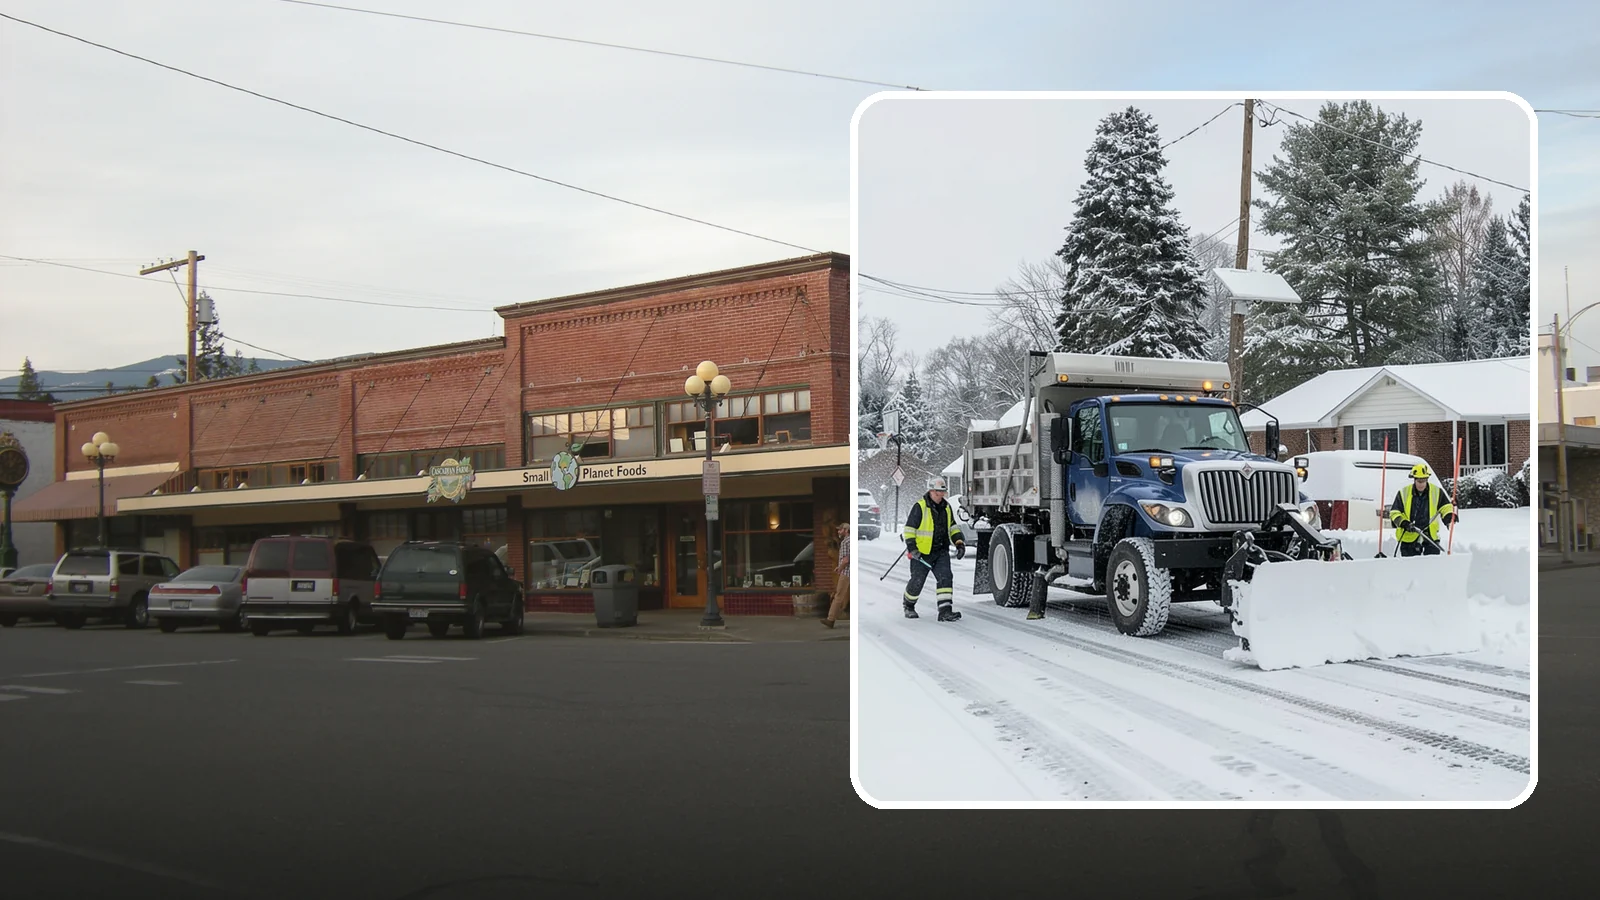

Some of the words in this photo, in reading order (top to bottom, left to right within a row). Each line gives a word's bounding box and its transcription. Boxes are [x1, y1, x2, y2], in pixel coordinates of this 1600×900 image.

[523, 471, 549, 483] Small
[582, 467, 614, 479] Planet
[616, 464, 647, 477] Foods
